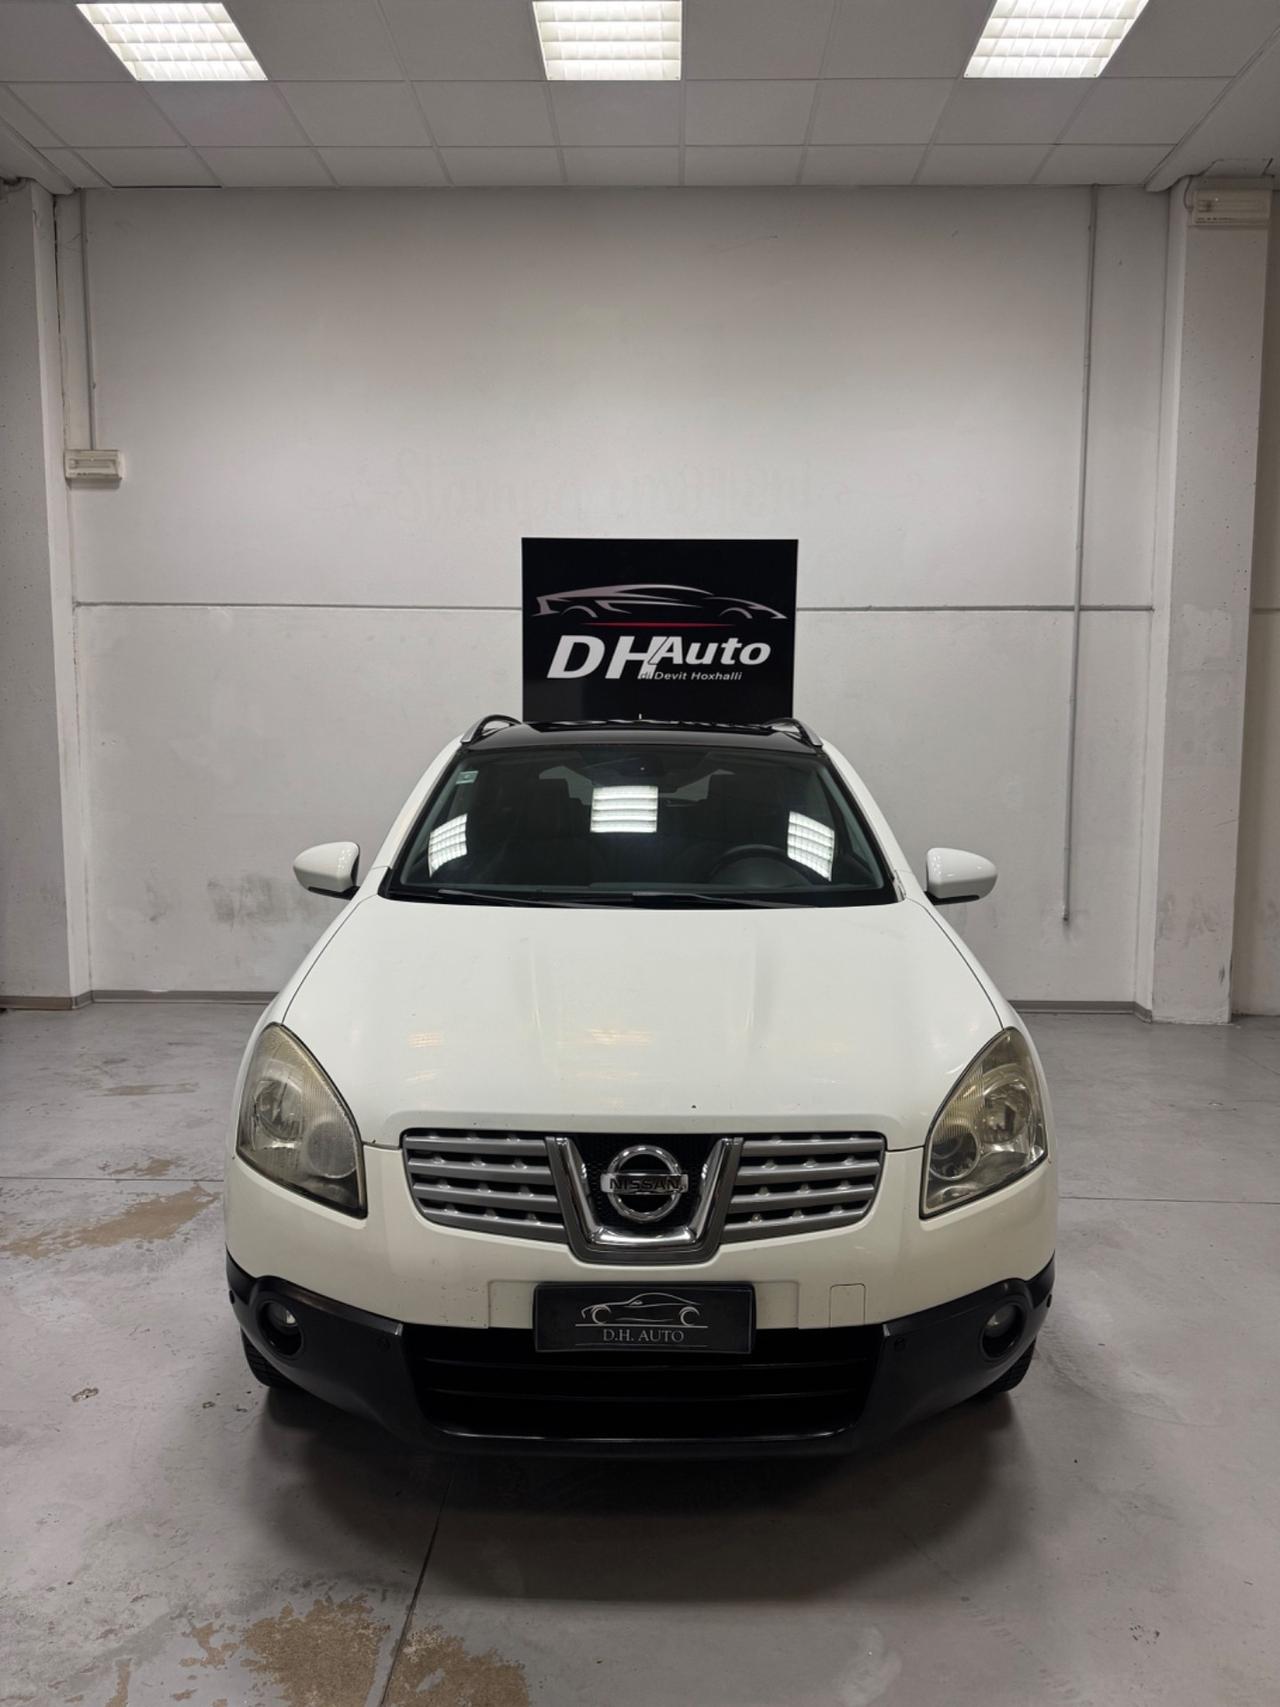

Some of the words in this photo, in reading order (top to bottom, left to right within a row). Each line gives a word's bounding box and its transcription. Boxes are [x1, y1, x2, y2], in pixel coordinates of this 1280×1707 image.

[653, 671, 687, 680] Devit
[690, 671, 743, 681] Hoxhalli
[609, 1178, 680, 1190] NISSAN
[603, 1328, 634, 1342] D.H.
[639, 1329, 684, 1342] AUTO
